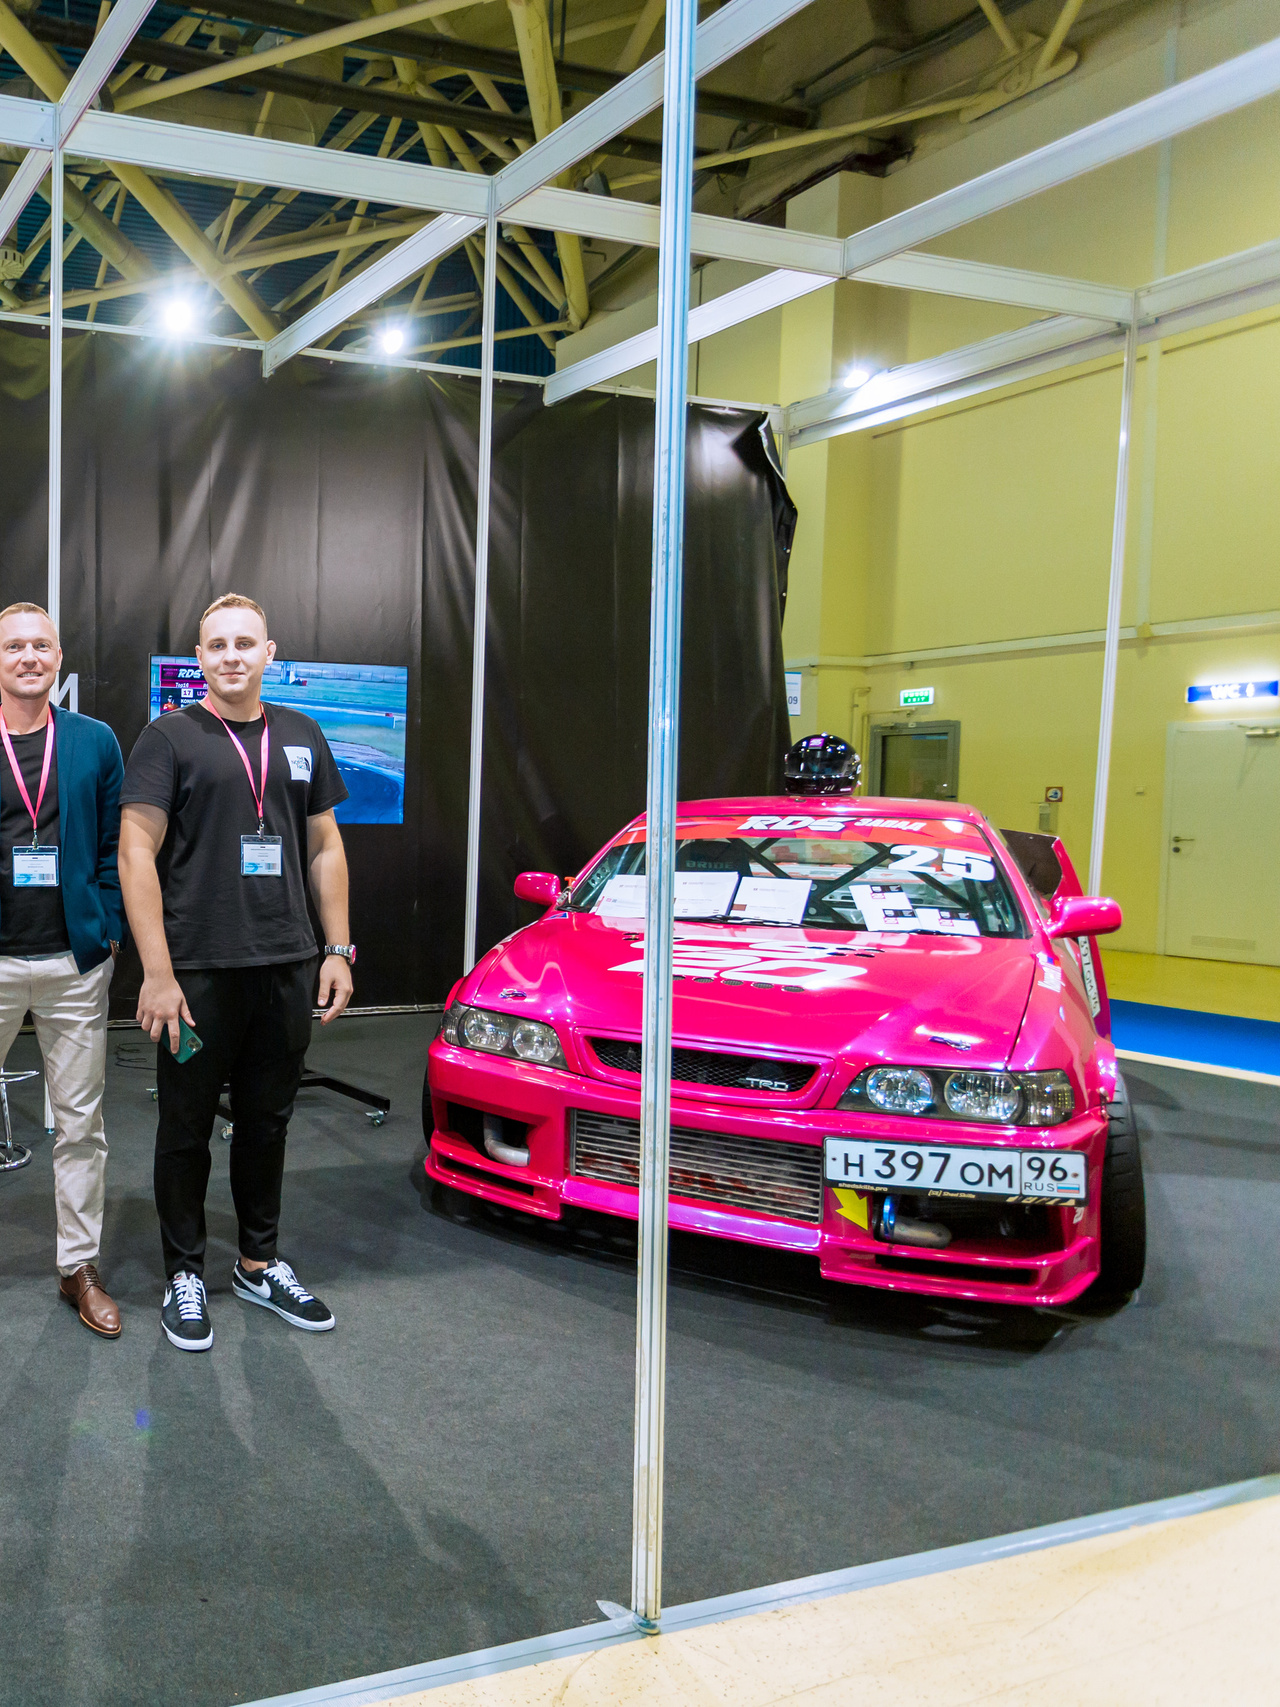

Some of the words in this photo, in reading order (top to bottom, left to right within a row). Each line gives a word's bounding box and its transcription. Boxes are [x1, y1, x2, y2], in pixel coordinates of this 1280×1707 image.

[737, 815, 857, 832] RDS
[888, 844, 995, 882] 25
[745, 1077, 789, 1092] TRD
[874, 1149, 952, 1183] 397
[1027, 1156, 1068, 1181] 96
[1024, 1182, 1055, 1192] RUS
